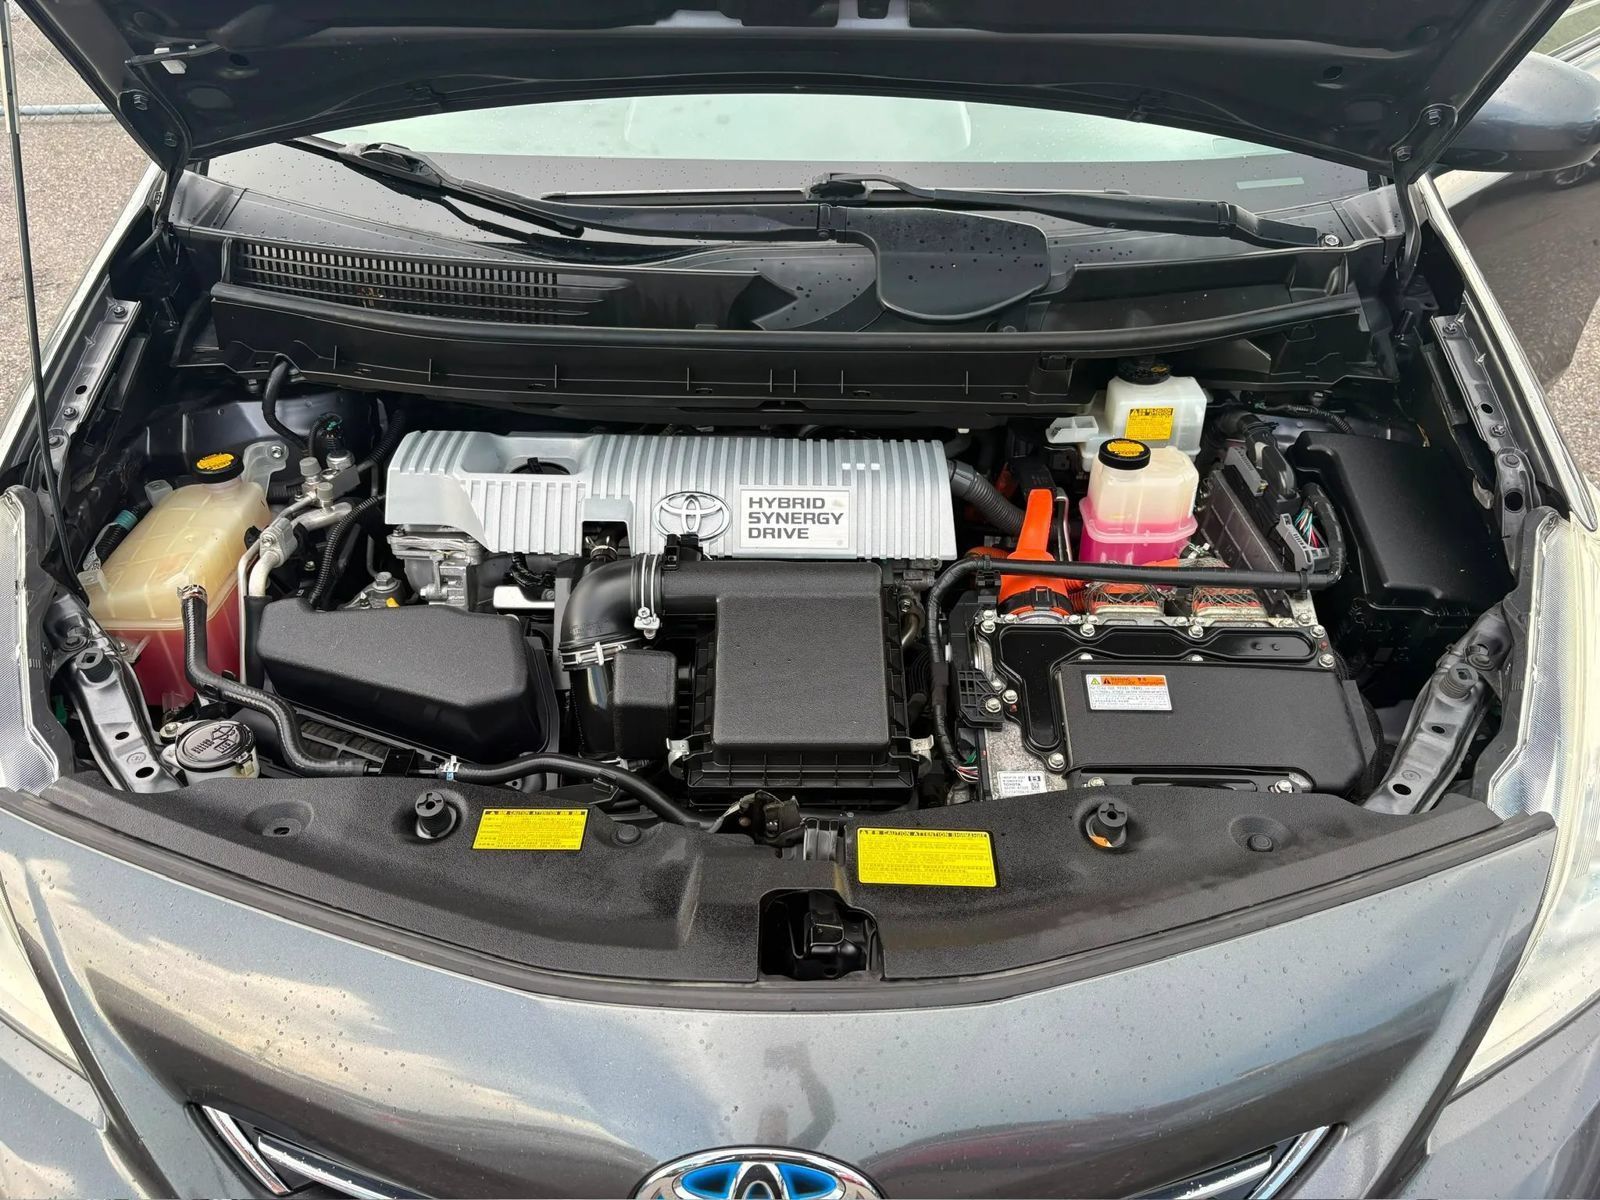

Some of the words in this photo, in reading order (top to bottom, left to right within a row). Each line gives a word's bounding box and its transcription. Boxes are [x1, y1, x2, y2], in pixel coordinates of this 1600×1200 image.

[749, 497, 826, 509] HYBRID
[748, 511, 844, 525] SYNERGY
[748, 527, 809, 539] DRIVE
